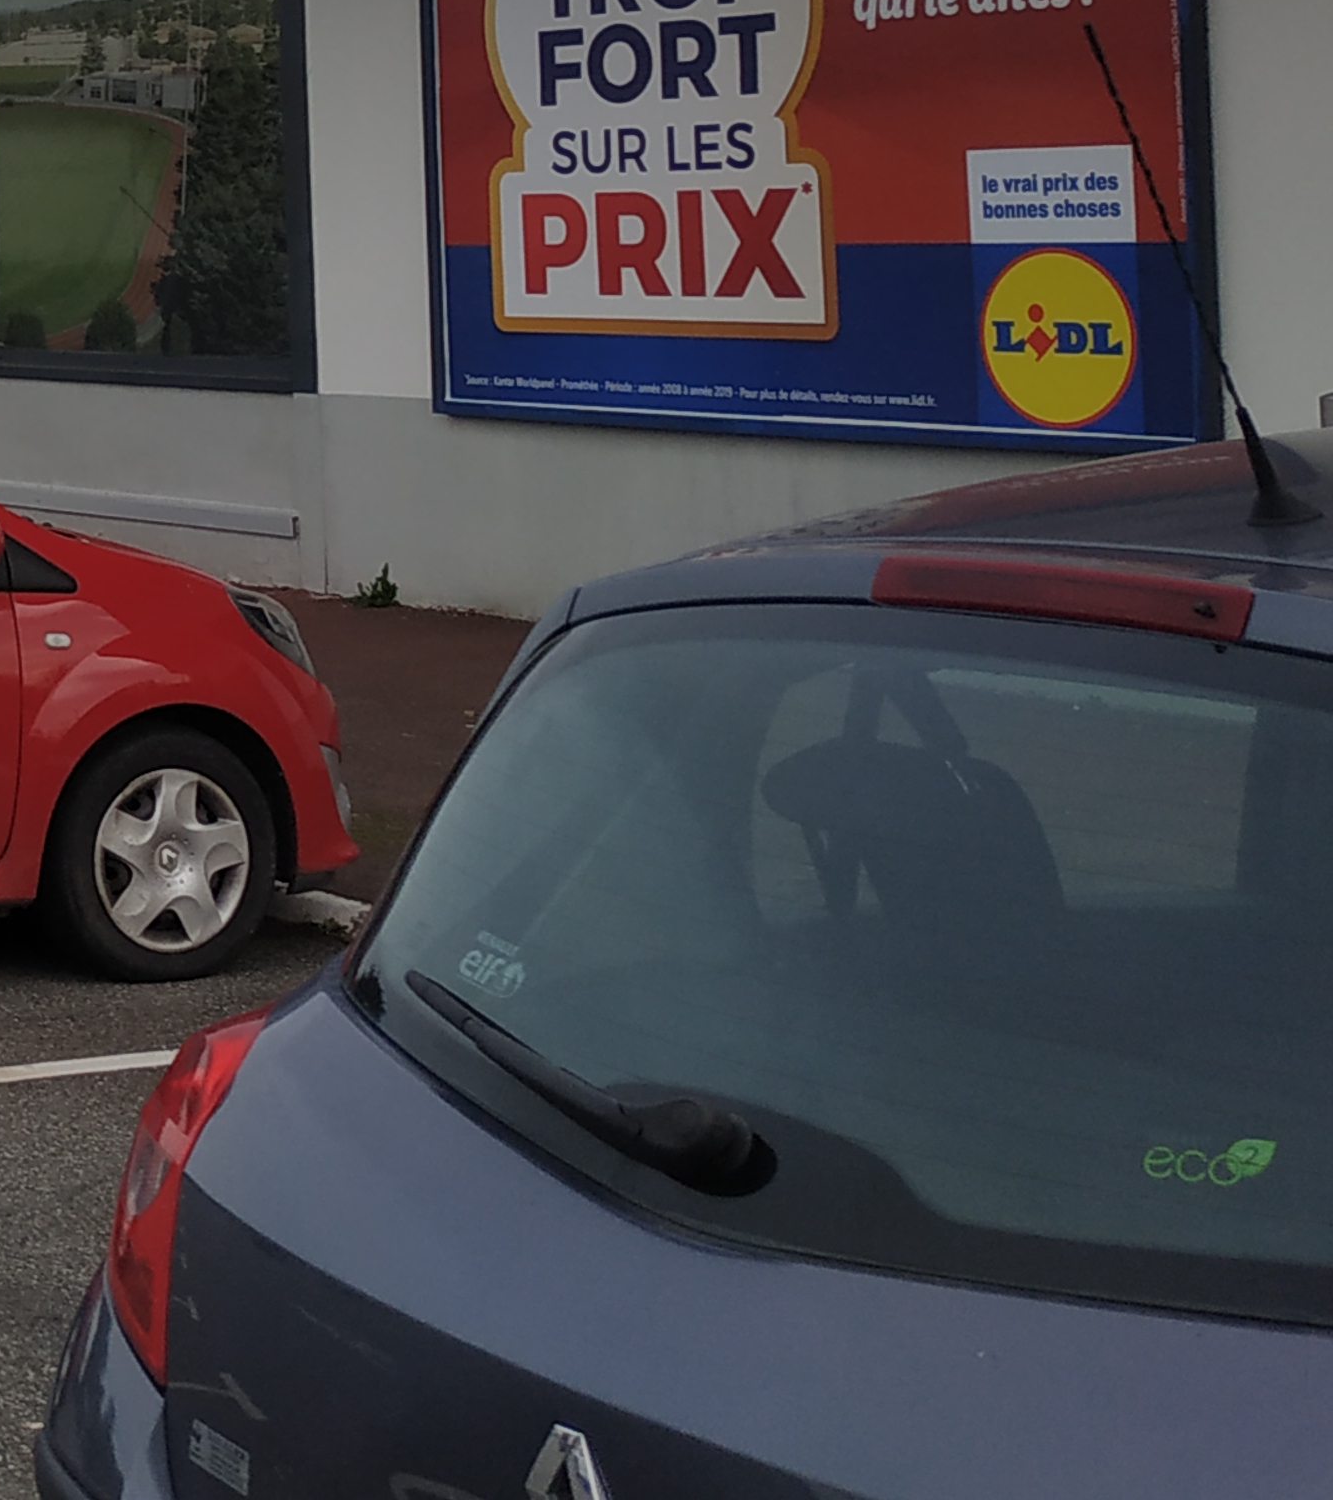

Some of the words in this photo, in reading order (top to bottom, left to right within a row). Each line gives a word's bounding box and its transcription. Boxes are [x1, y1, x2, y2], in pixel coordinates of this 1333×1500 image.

[538, 12, 776, 107] FORT
[551, 127, 648, 174] SUR
[667, 122, 755, 171] LES
[982, 175, 999, 193] le
[1002, 173, 1038, 192] vrai
[1042, 172, 1079, 196] prix
[1084, 171, 1119, 191] des
[982, 200, 1049, 218] bonnes
[1053, 199, 1121, 218] choses
